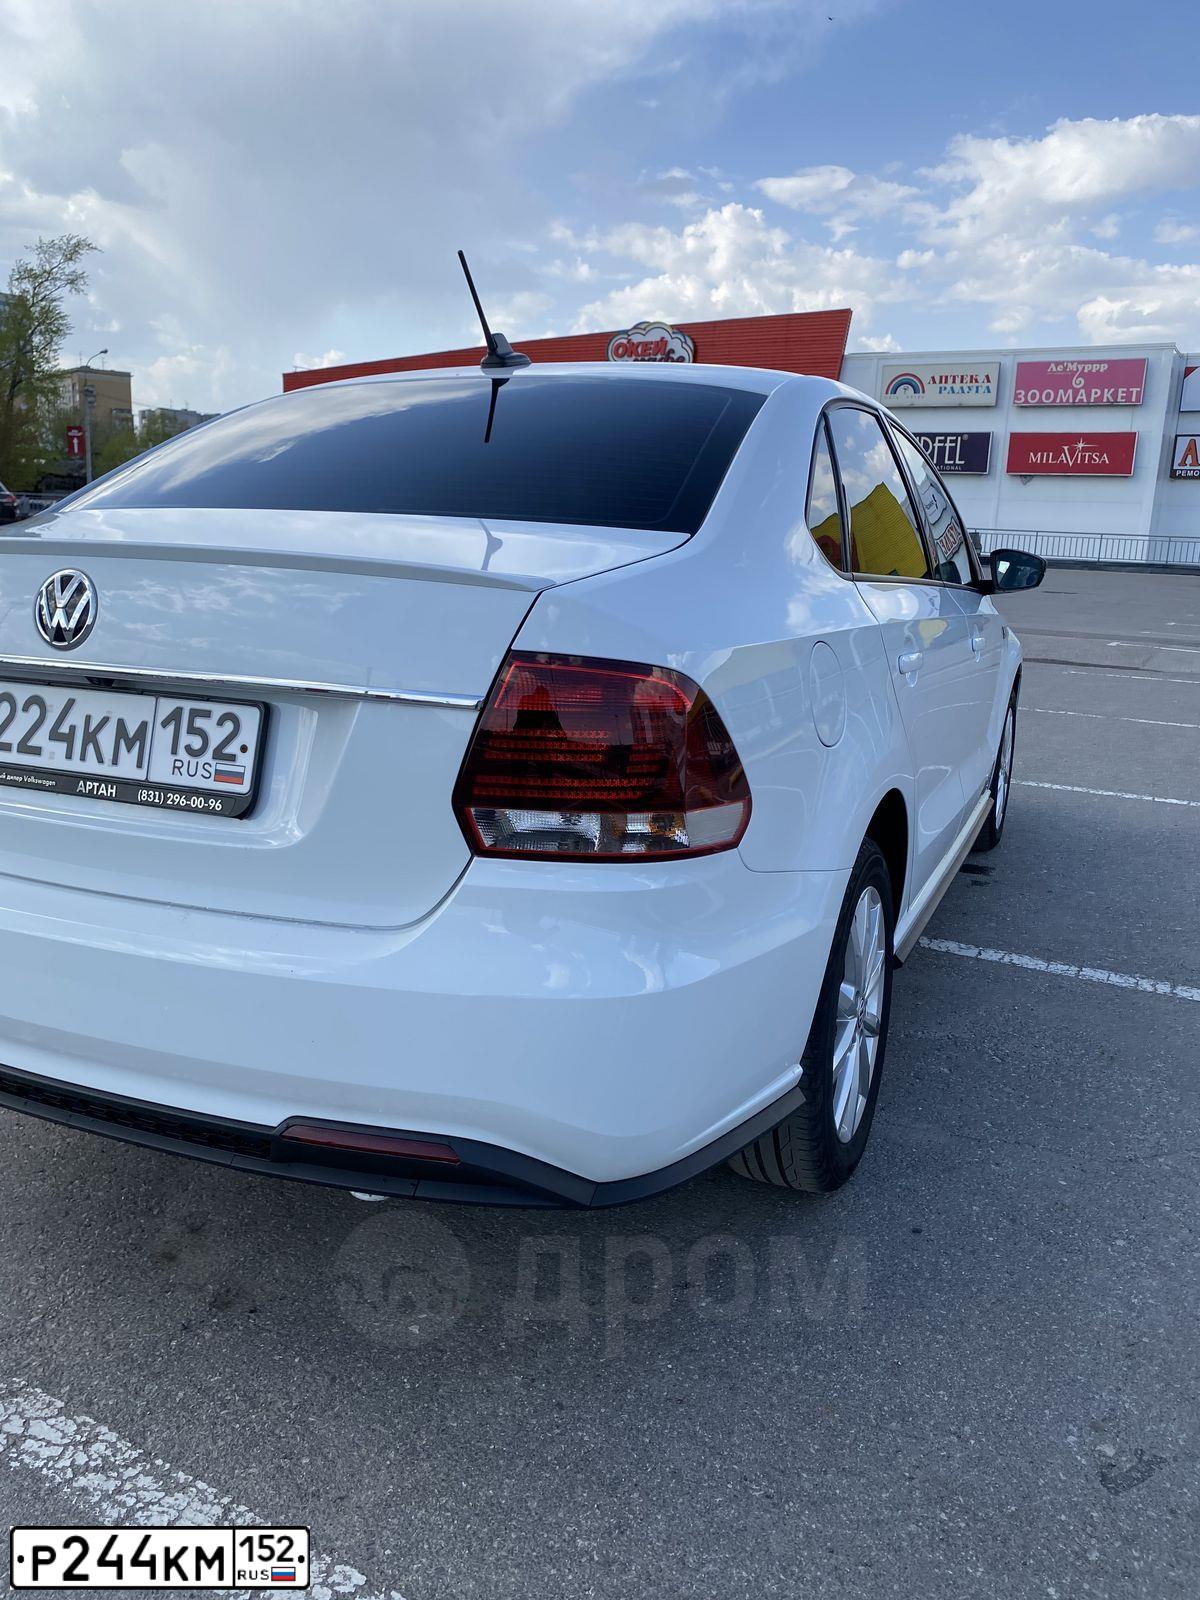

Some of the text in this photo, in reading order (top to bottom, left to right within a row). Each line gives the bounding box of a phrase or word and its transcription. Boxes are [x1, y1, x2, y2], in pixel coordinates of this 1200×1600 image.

[927, 374, 992, 385] АПТЕКА
[1014, 388, 1141, 404] ЗООМАРКЕТ
[1028, 446, 1110, 467] MILAVITSA
[161, 706, 241, 762] 152
[172, 758, 212, 779] RUS
[23, 774, 56, 786] Volkswagen
[76, 780, 117, 798] АРТАН
[137, 789, 165, 804] (831)
[166, 793, 222, 812] 296-00-96
